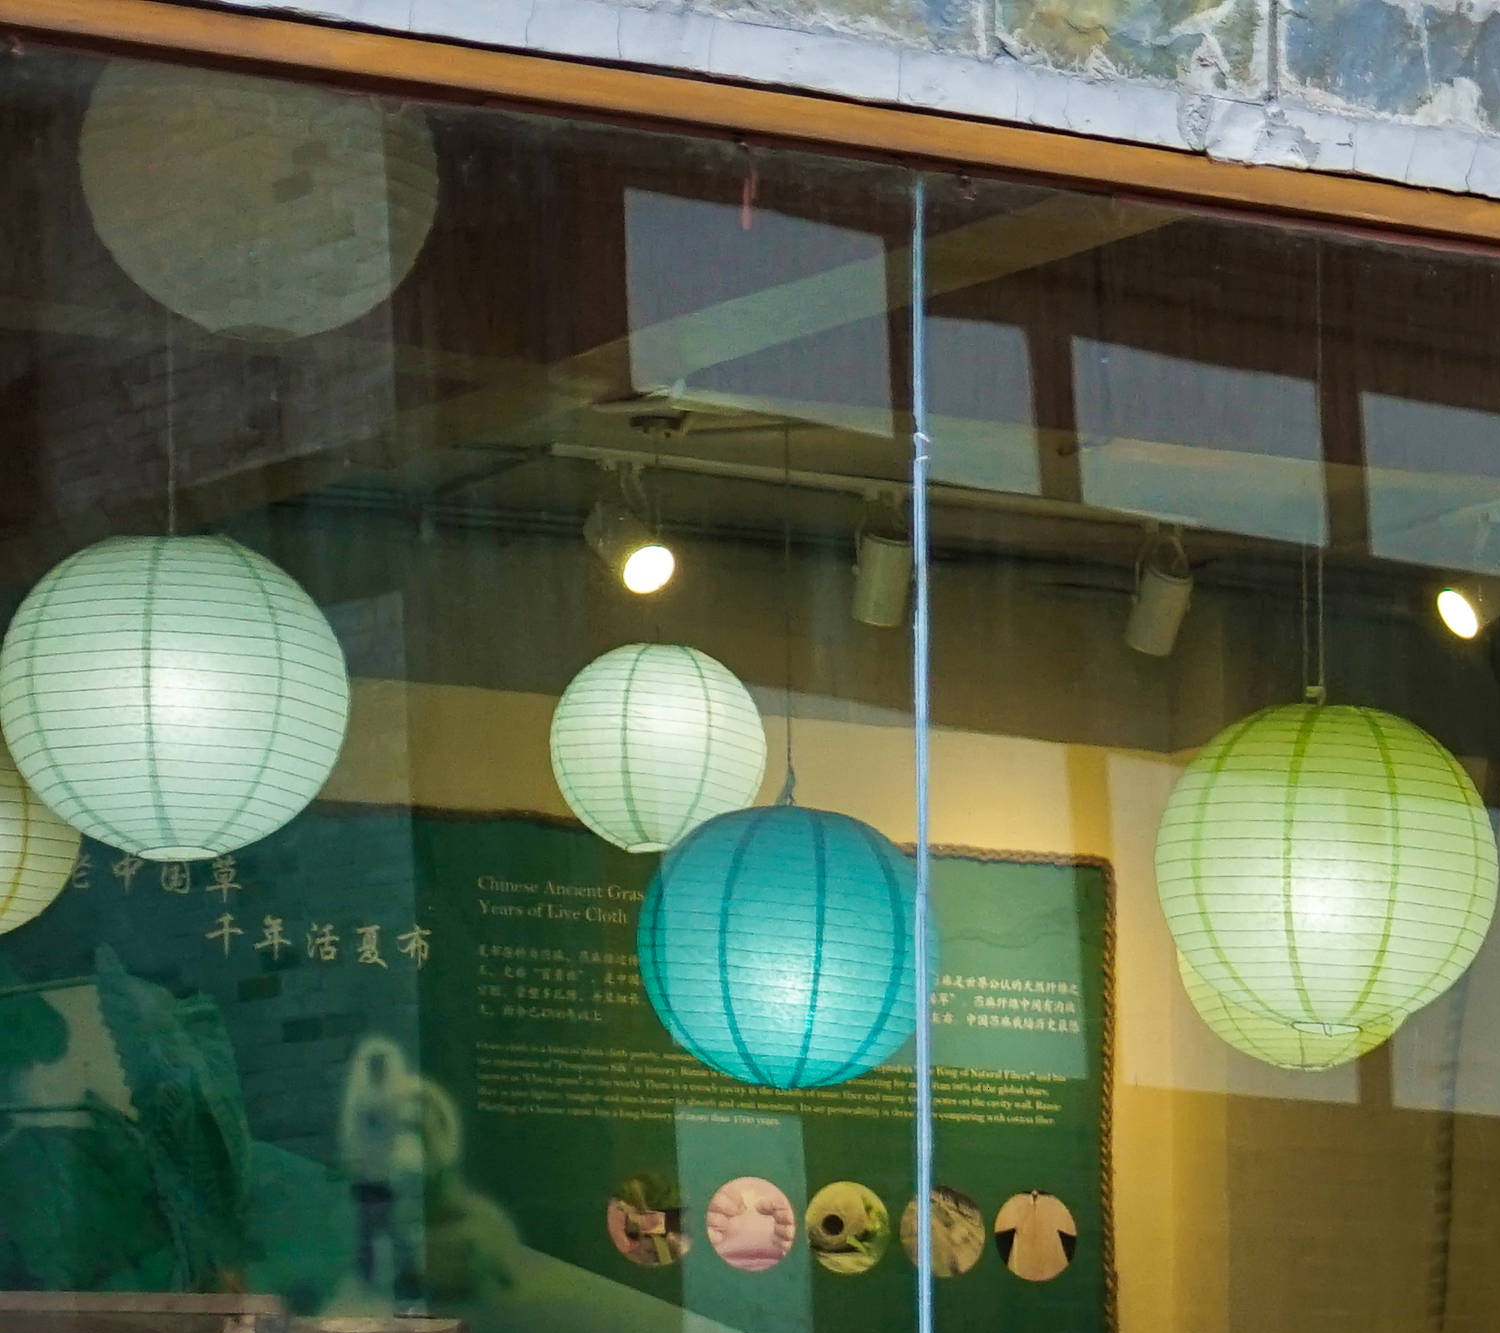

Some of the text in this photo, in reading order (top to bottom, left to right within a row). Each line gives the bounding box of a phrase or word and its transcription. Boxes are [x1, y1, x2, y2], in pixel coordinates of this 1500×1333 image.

[478, 876, 538, 894] Chinese
[545, 880, 603, 899] Ancient
[478, 900, 628, 924] Years of Live Cloth
[206, 913, 433, 970] 千年活夏布
